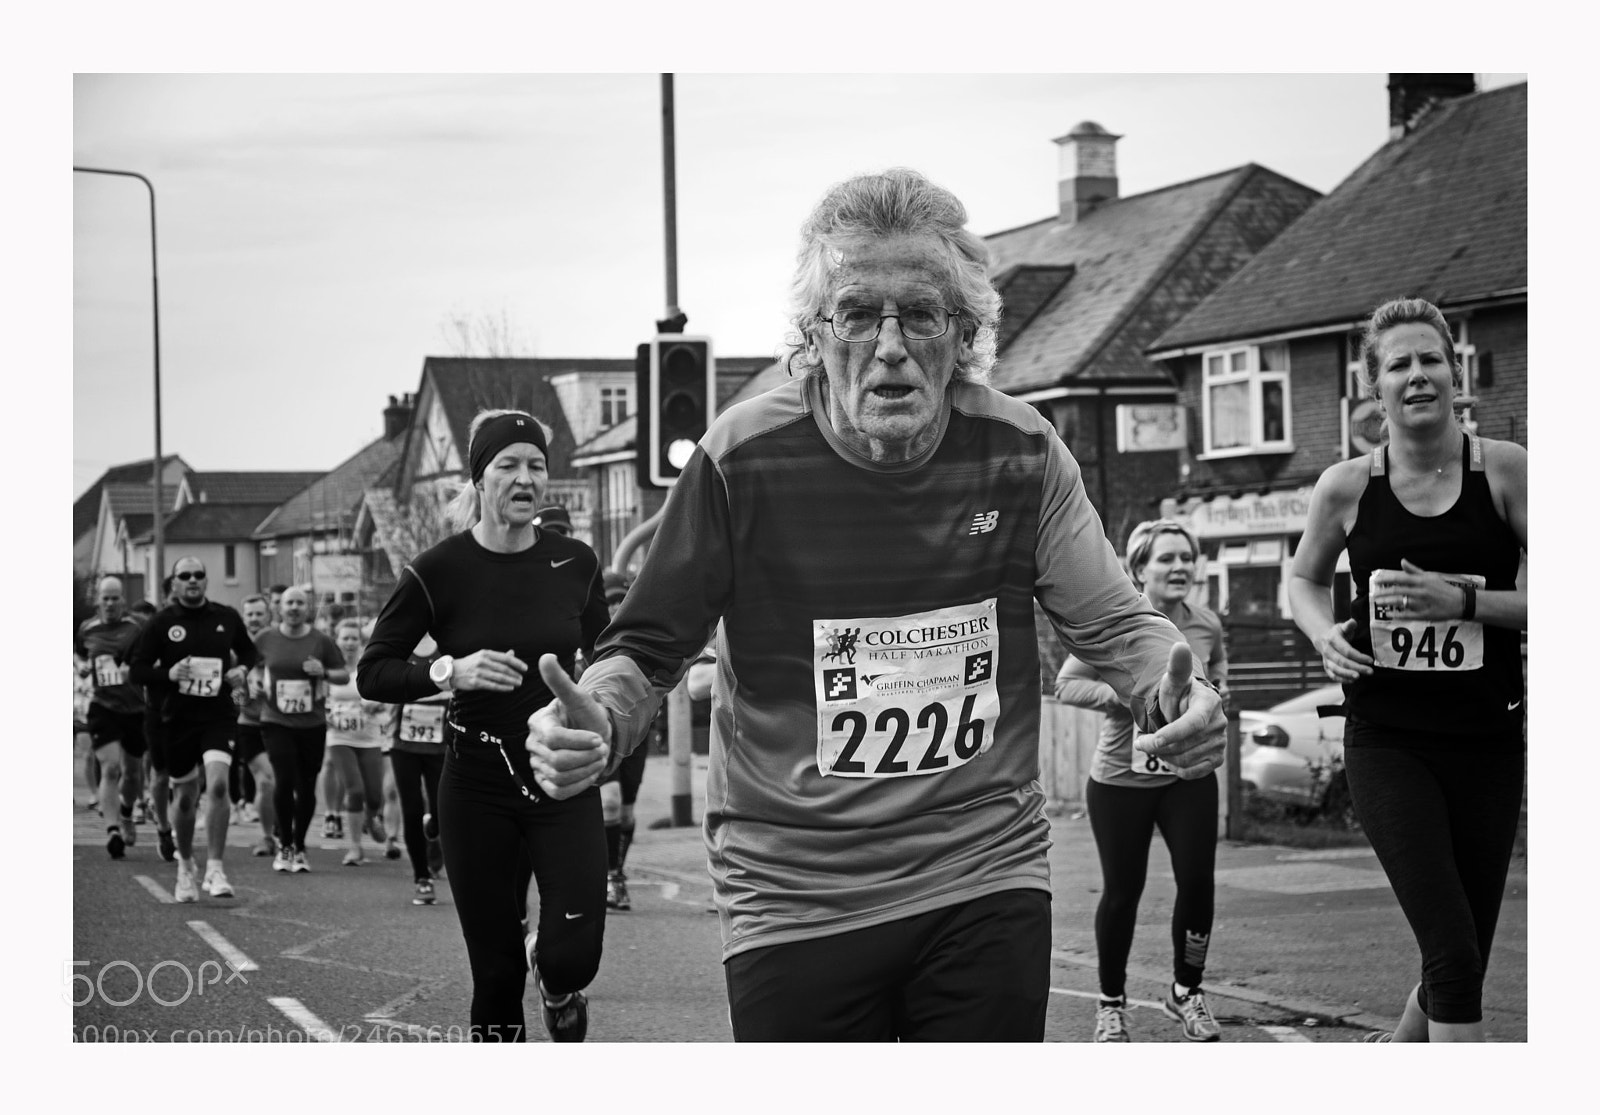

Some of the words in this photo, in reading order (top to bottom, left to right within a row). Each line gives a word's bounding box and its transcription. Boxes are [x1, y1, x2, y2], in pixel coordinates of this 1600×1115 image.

[865, 617, 990, 646] COLCHESTER
[869, 651, 907, 661] HALF
[913, 637, 989, 660] MARATHON
[1391, 626, 1465, 668] 946
[186, 679, 213, 696] 715
[876, 680, 914, 691] GRIFFIN
[916, 674, 960, 688] CHAPMAN
[408, 725, 435, 740] 393
[831, 693, 985, 774] 2226
